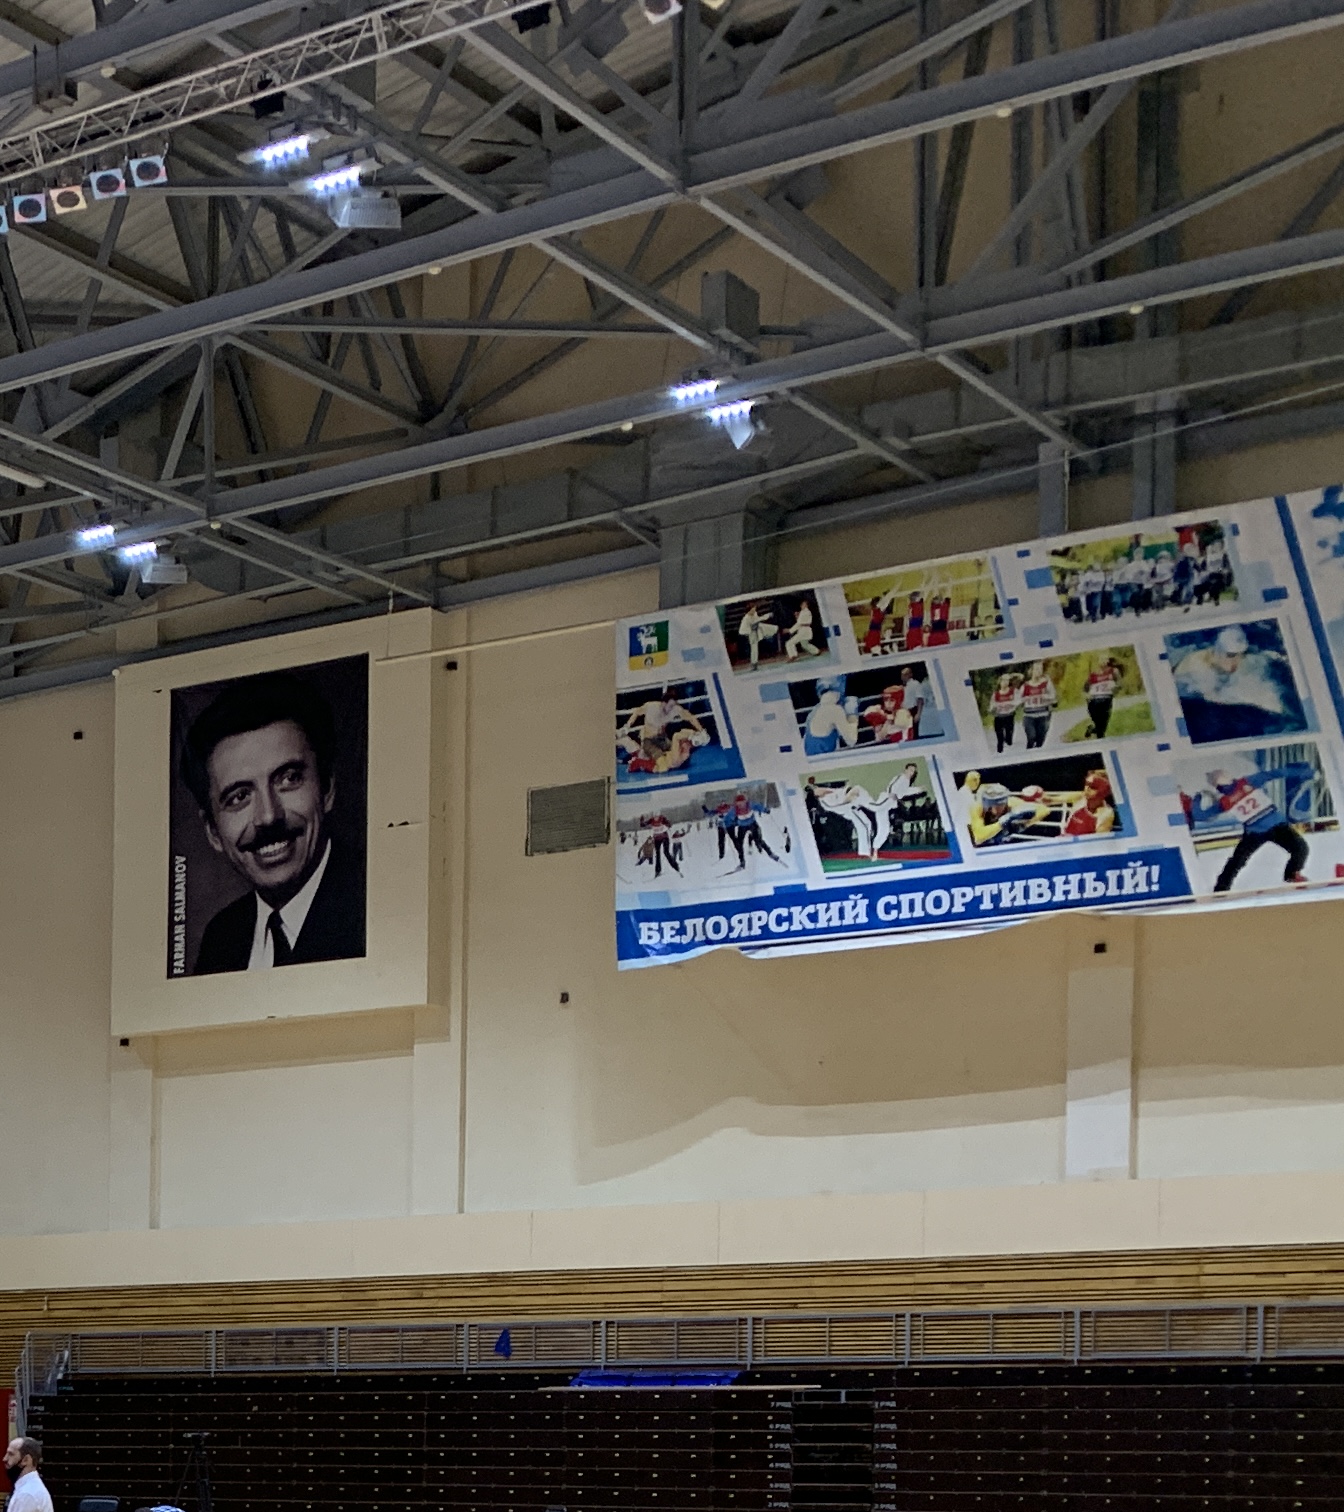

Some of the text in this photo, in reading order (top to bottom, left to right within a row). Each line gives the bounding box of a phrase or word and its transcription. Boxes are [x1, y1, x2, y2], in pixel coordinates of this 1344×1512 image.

[1238, 797, 1259, 816] 22
[174, 856, 186, 974] FARMAN SALMANOV
[638, 862, 1161, 945] БЕЛОЯРСКИЙ СПОРТИВНЫЙ!
